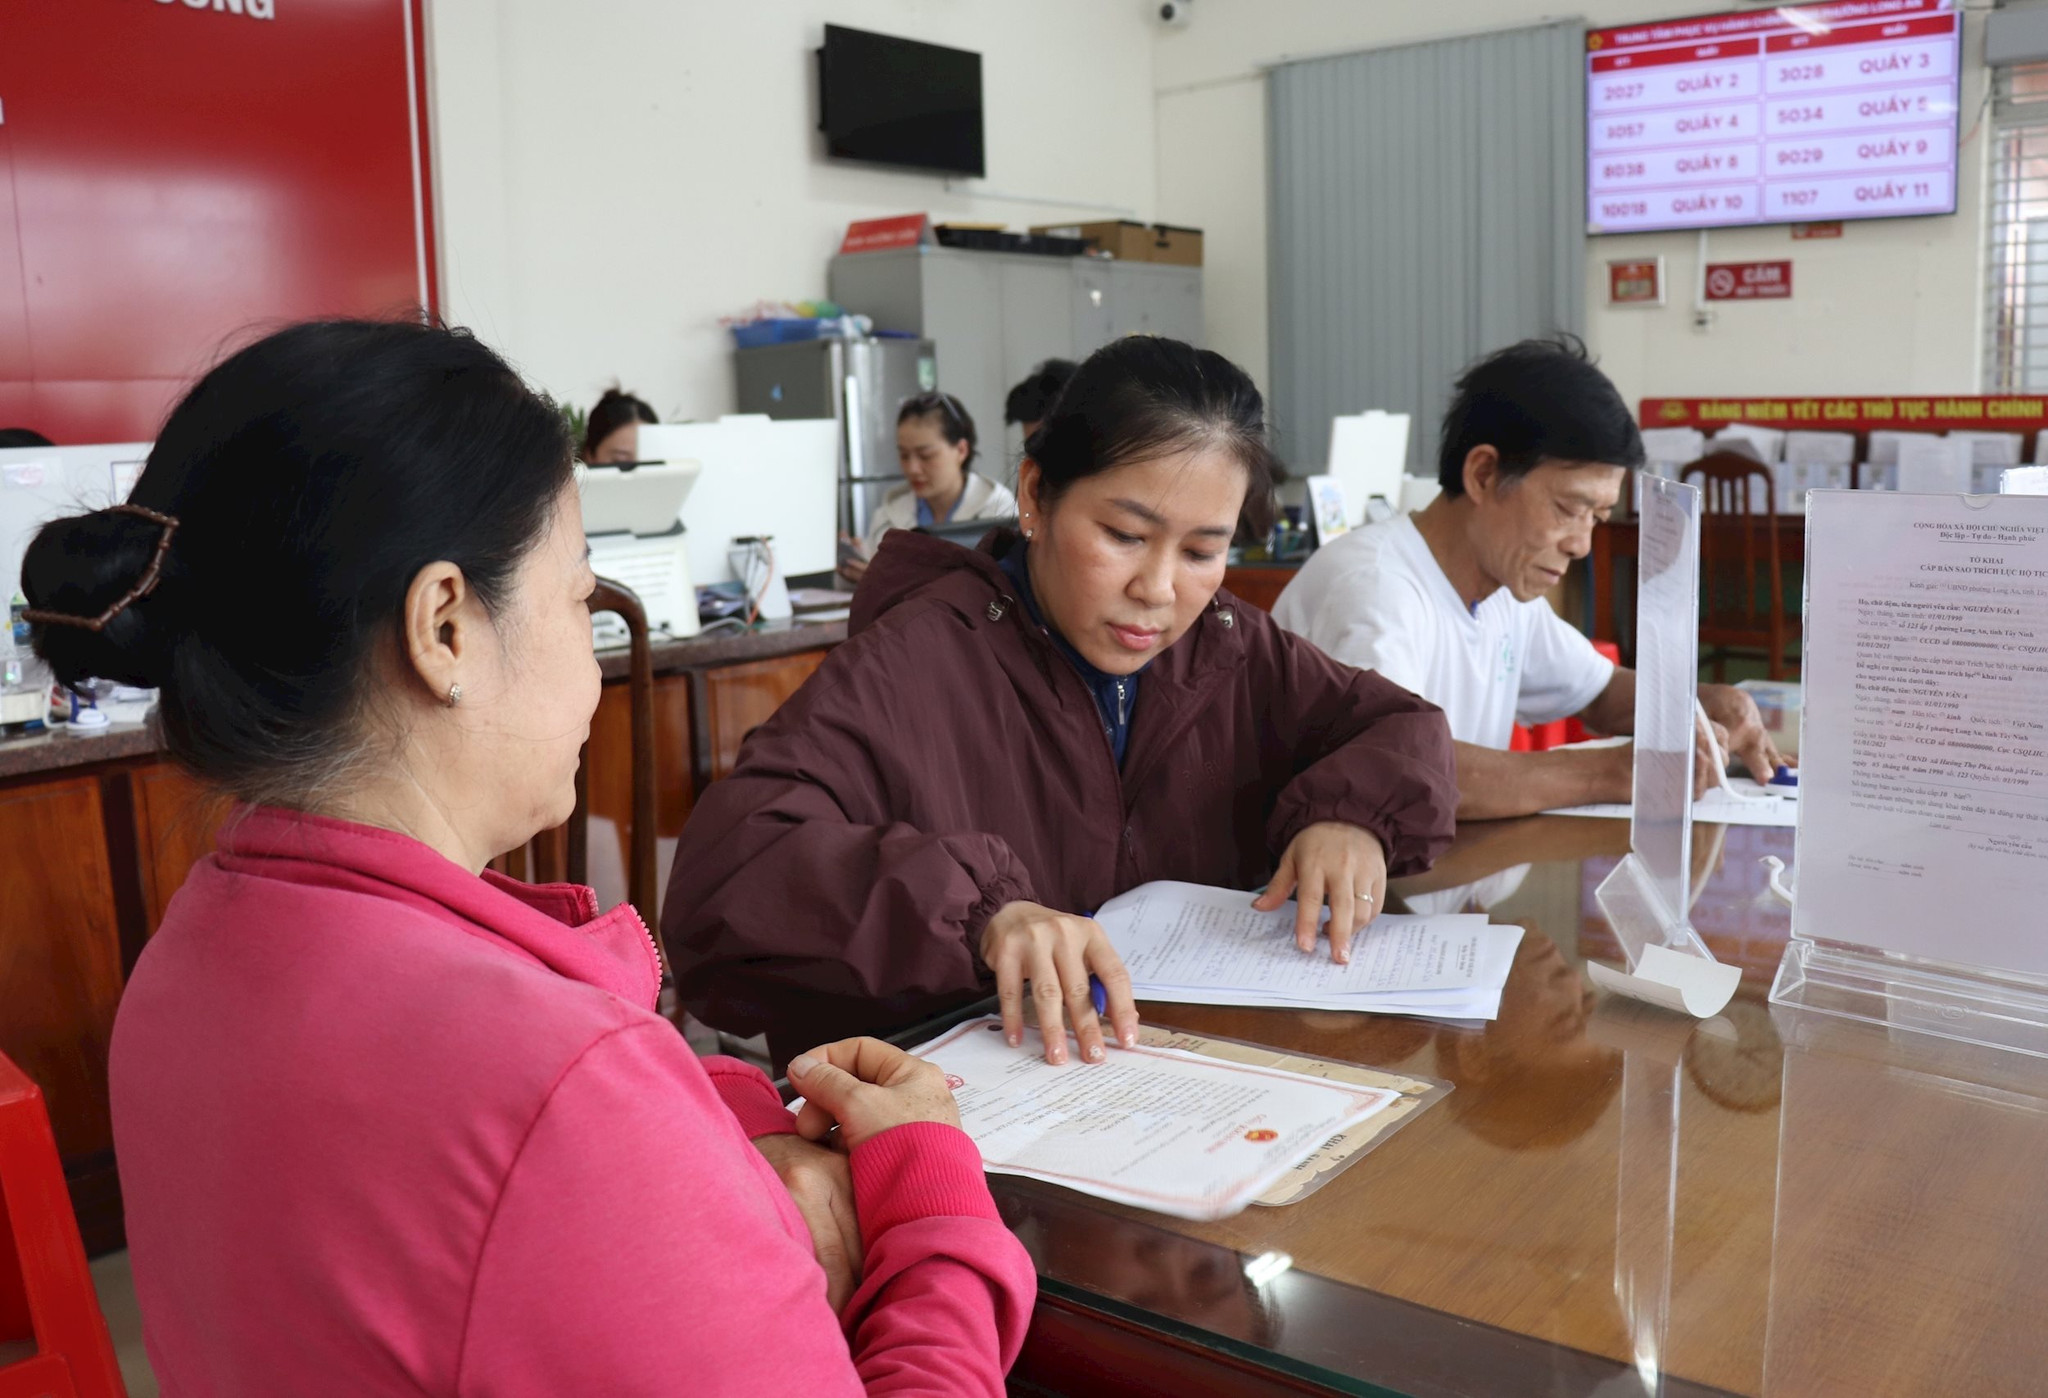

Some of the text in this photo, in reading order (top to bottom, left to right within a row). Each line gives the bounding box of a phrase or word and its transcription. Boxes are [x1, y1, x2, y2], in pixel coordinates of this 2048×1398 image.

[1779, 64, 1824, 83] 3028
[1919, 53, 1930, 68] 3
[1604, 83, 1645, 101] 2027
[1728, 73, 1739, 87] 2
[1778, 106, 1823, 124] 5034
[1917, 97, 1928, 112] 5
[1728, 115, 1739, 128] 4
[1916, 139, 1928, 154] 9
[1728, 155, 1739, 169] 8
[1914, 182, 1929, 197] 11
[1724, 195, 1743, 210] 10
[1824, 400, 1857, 420] CÁC
[1862, 398, 1894, 419] THỦ
[1900, 400, 1929, 421] TỤC
[1934, 399, 1983, 418] HÀNH
[1987, 399, 2044, 418] CHÍNH
[1940, 531, 1953, 539] Độc
[1954, 532, 1965, 540] lập
[1998, 533, 2016, 542] Hạnh
[2018, 534, 2036, 543] phúc
[1970, 556, 1981, 564] TỜ
[1955, 566, 1972, 574] SAO
[1973, 566, 1999, 575] TRÍCH
[2001, 568, 2018, 577] LỤC
[2019, 570, 2032, 578] HỘ
[2034, 570, 2048, 578] TỊC
[1962, 605, 1994, 614] NGUYỄN
[1927, 613, 1963, 621] 01/01/1990
[1960, 627, 1976, 635] Long
[1955, 727, 1972, 736] Long
[1915, 737, 1936, 745] CCCD
[1957, 771, 1969, 779] 123
[2002, 776, 2029, 786] 01/1990
